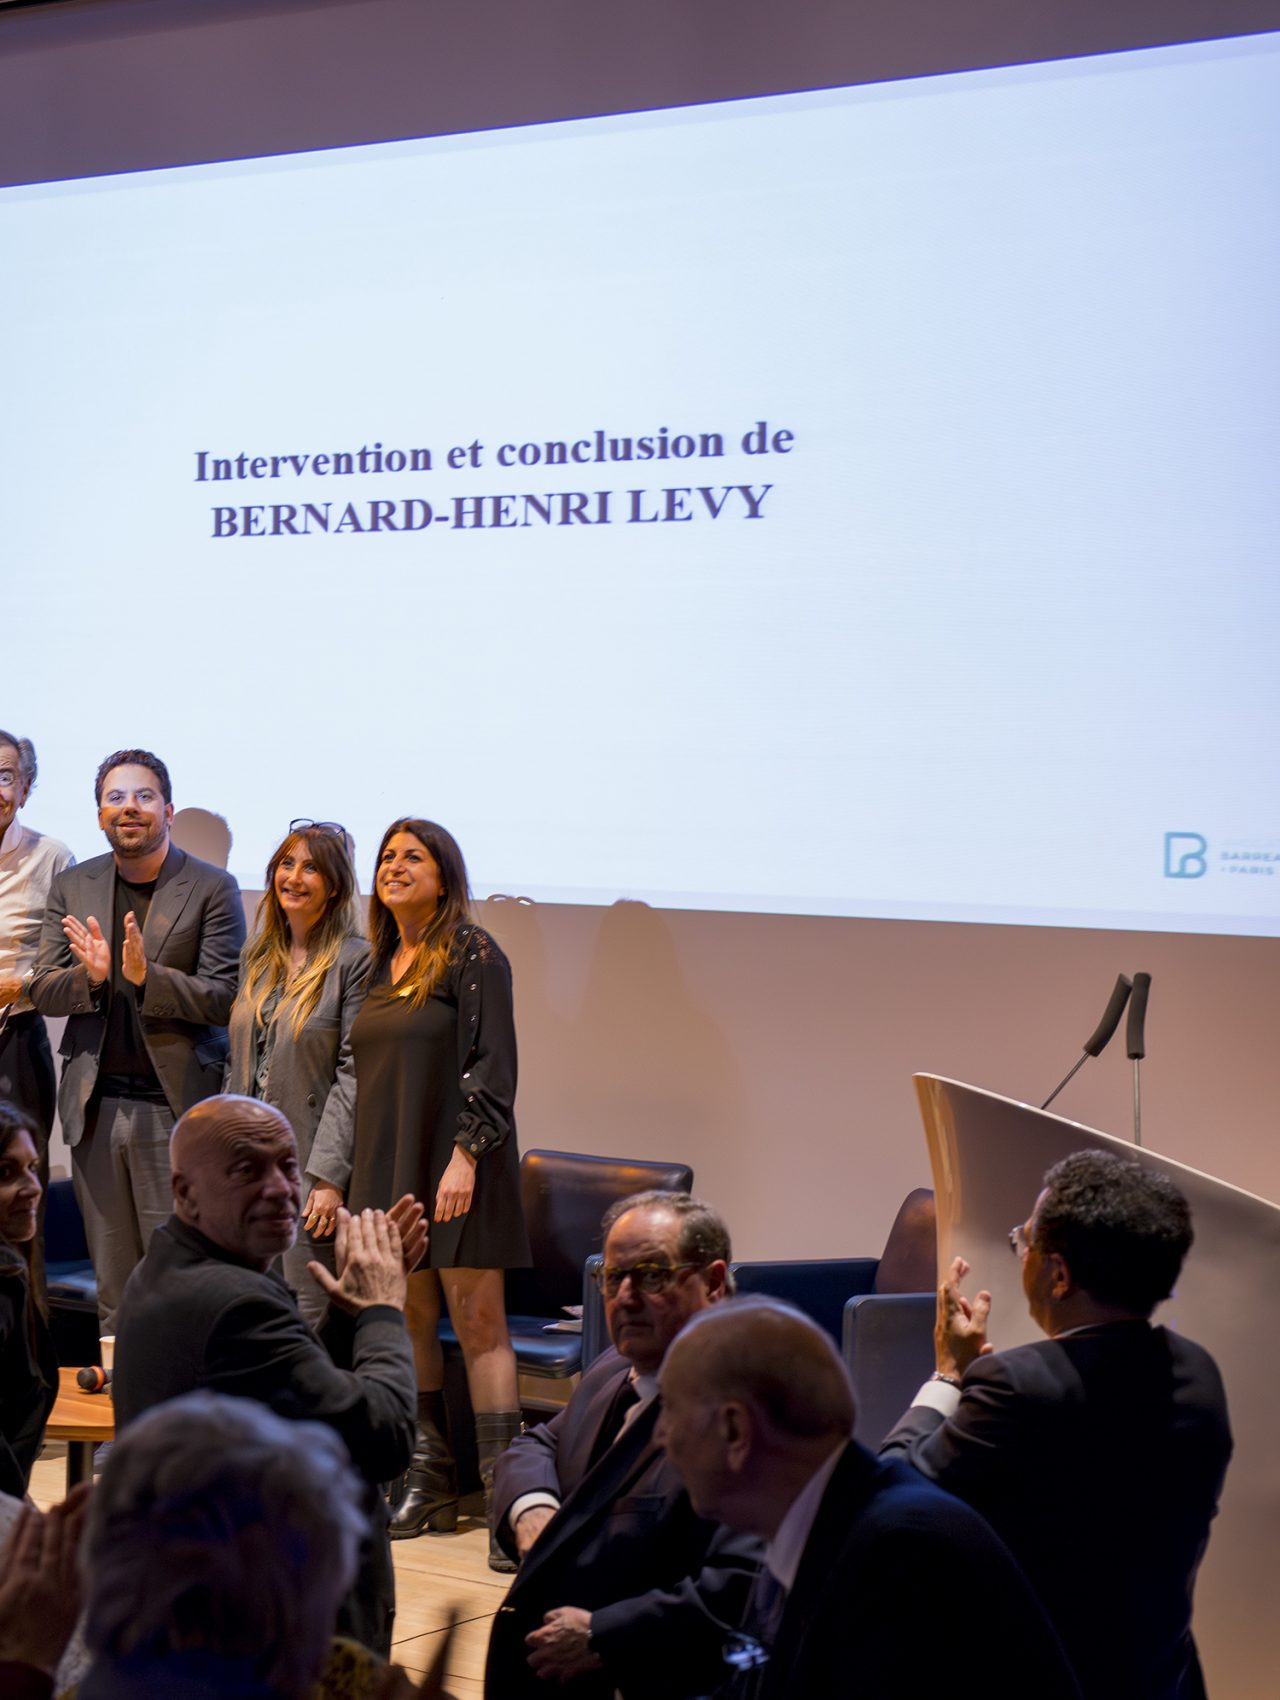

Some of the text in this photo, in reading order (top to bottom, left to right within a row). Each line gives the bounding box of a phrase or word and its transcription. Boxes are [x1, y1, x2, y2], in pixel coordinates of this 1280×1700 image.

[194, 420, 795, 482] Intervention et conclusion de
[211, 484, 774, 538] BERNARD-HENRI LEVY
